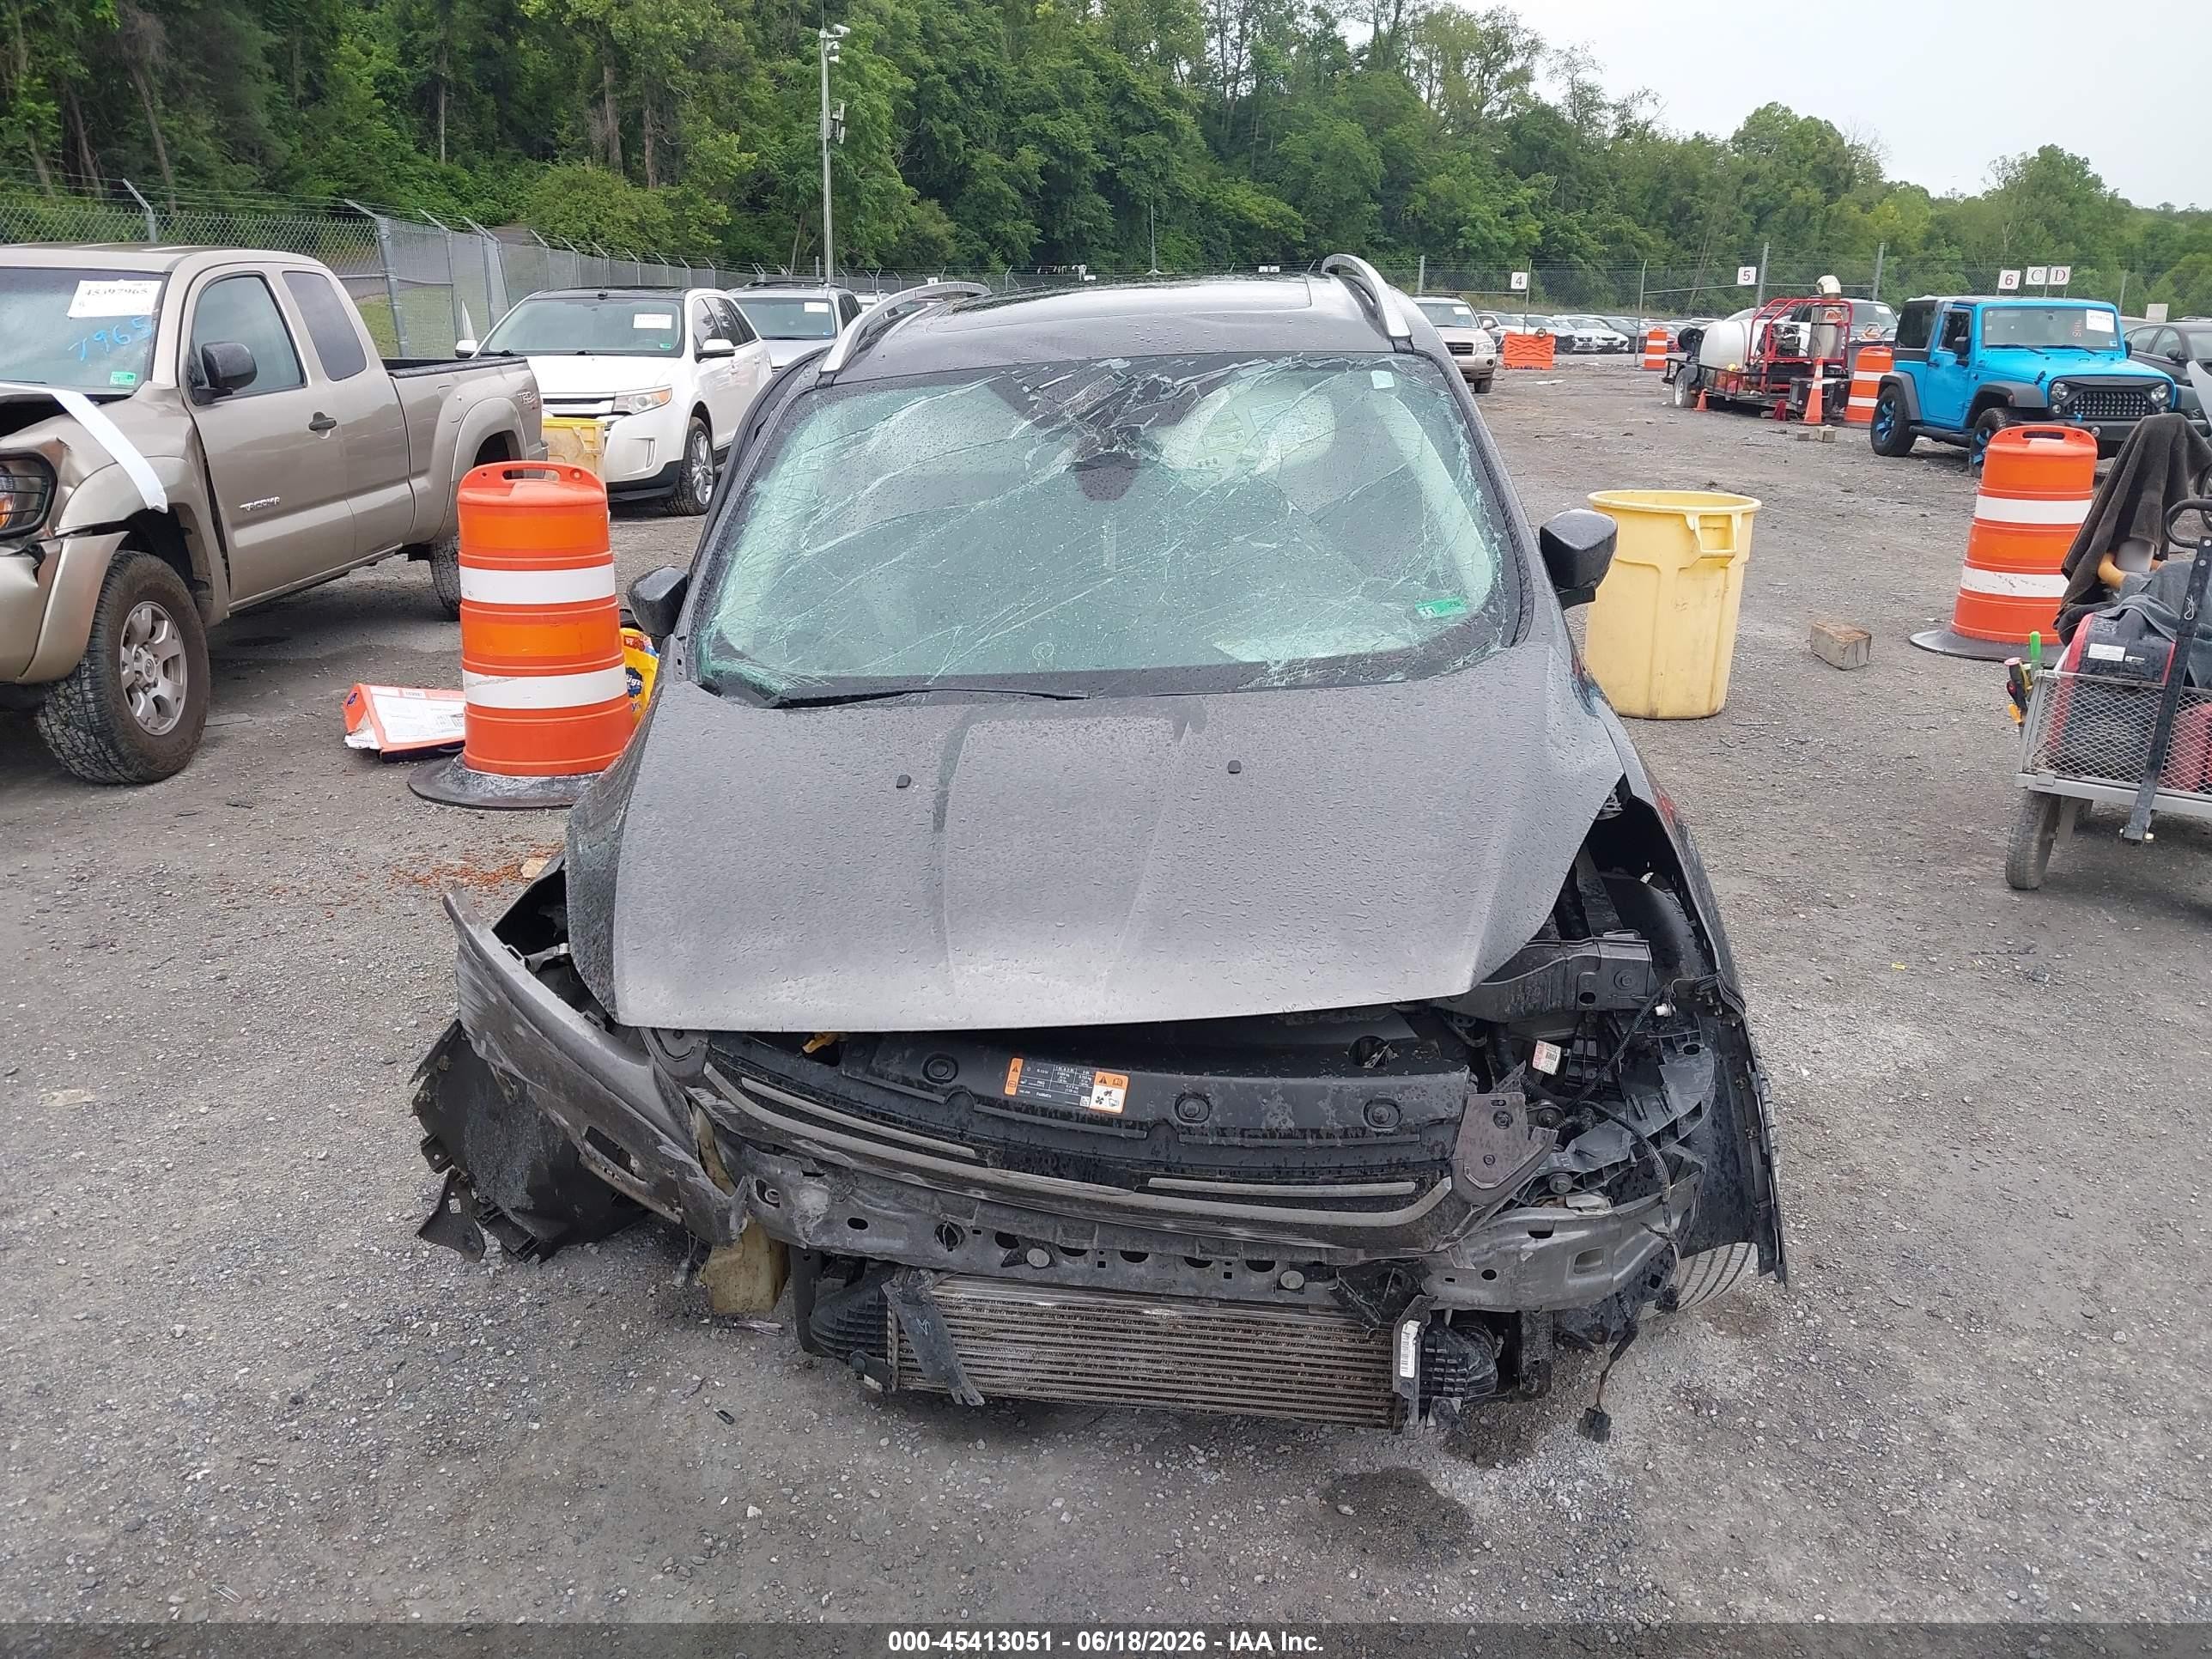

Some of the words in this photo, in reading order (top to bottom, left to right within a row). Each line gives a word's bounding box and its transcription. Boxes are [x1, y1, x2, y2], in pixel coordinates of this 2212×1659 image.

[1515, 276, 1522, 286] 4
[1743, 270, 1751, 282] 5
[2004, 274, 2014, 286] 6
[2031, 269, 2042, 282] C
[2054, 269, 2066, 282] D
